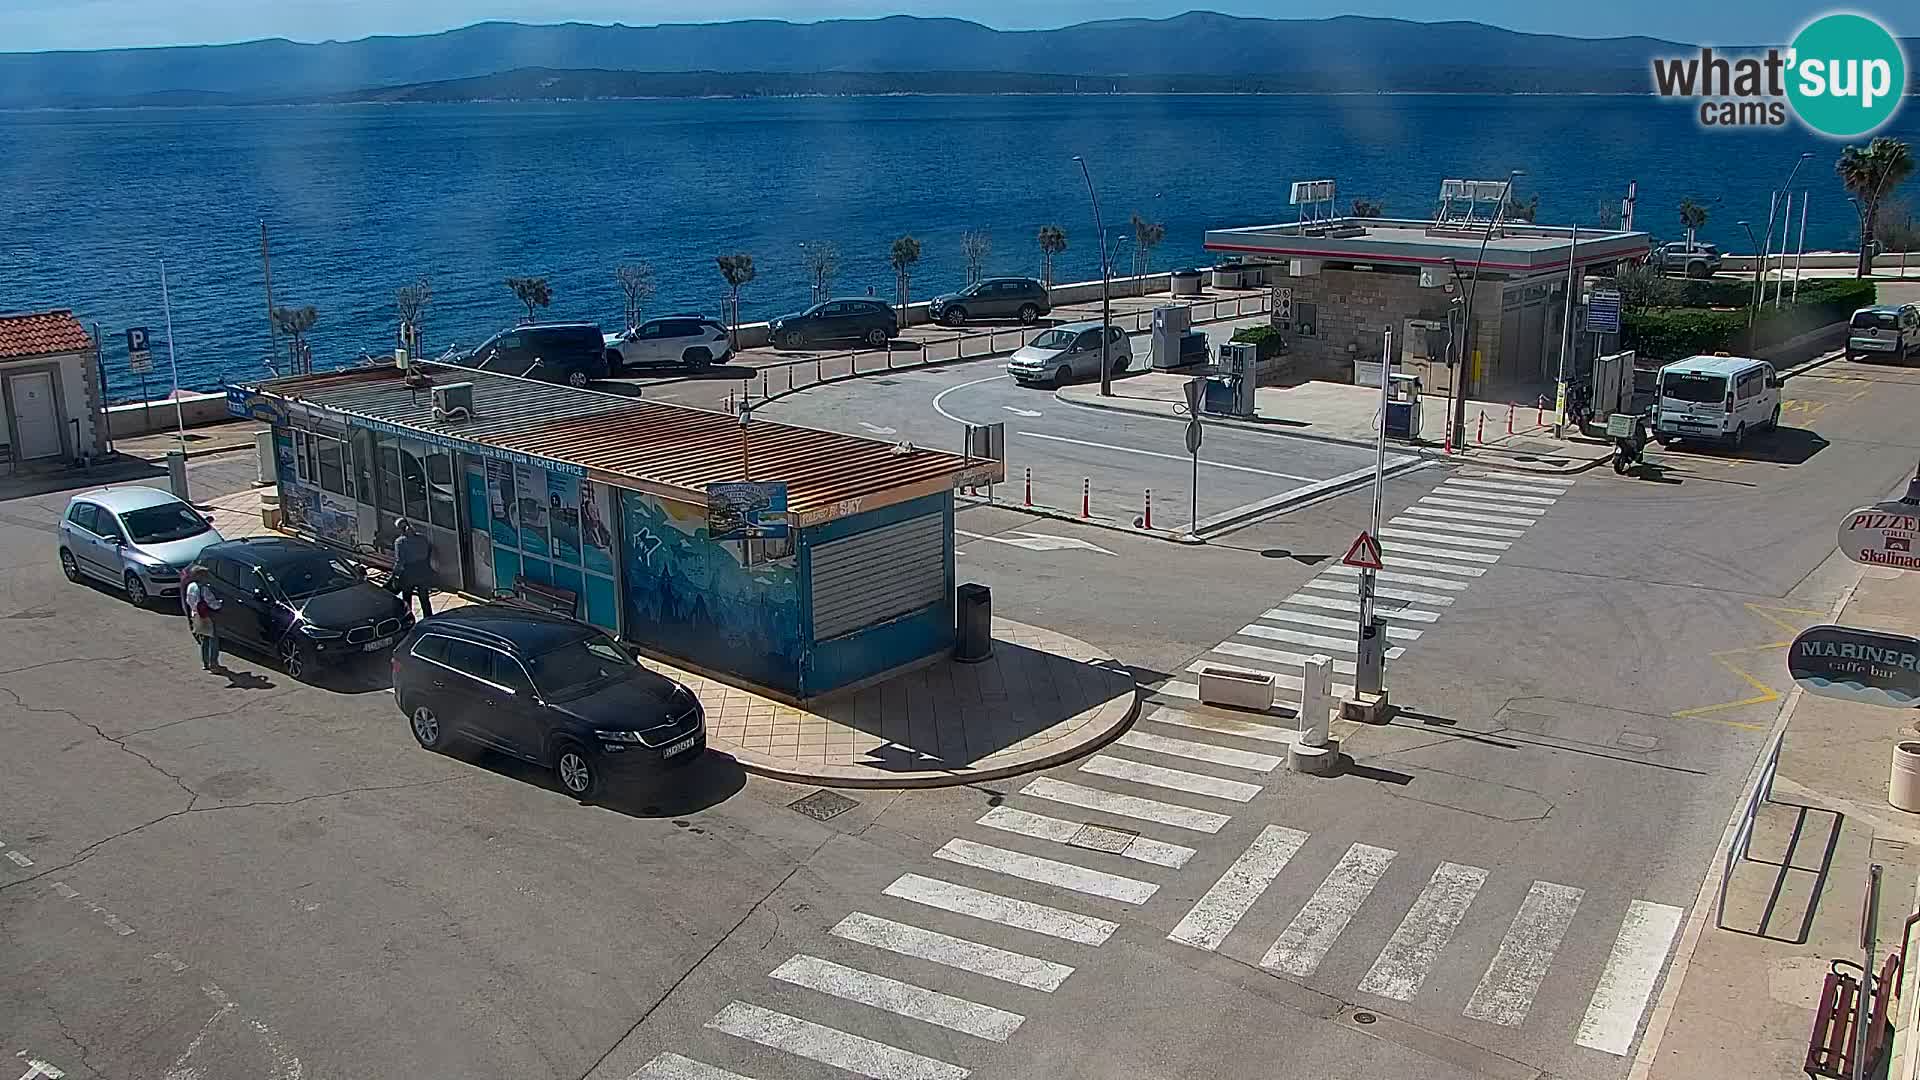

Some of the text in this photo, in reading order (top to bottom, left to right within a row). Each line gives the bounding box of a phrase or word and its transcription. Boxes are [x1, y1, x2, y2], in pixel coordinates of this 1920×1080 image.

[131, 330, 144, 349] P
[495, 448, 527, 464] STATION
[530, 456, 556, 471] TICKET
[557, 464, 584, 476] OFFICE
[1848, 514, 1920, 532] PIZZE
[1870, 664, 1896, 679] bar
